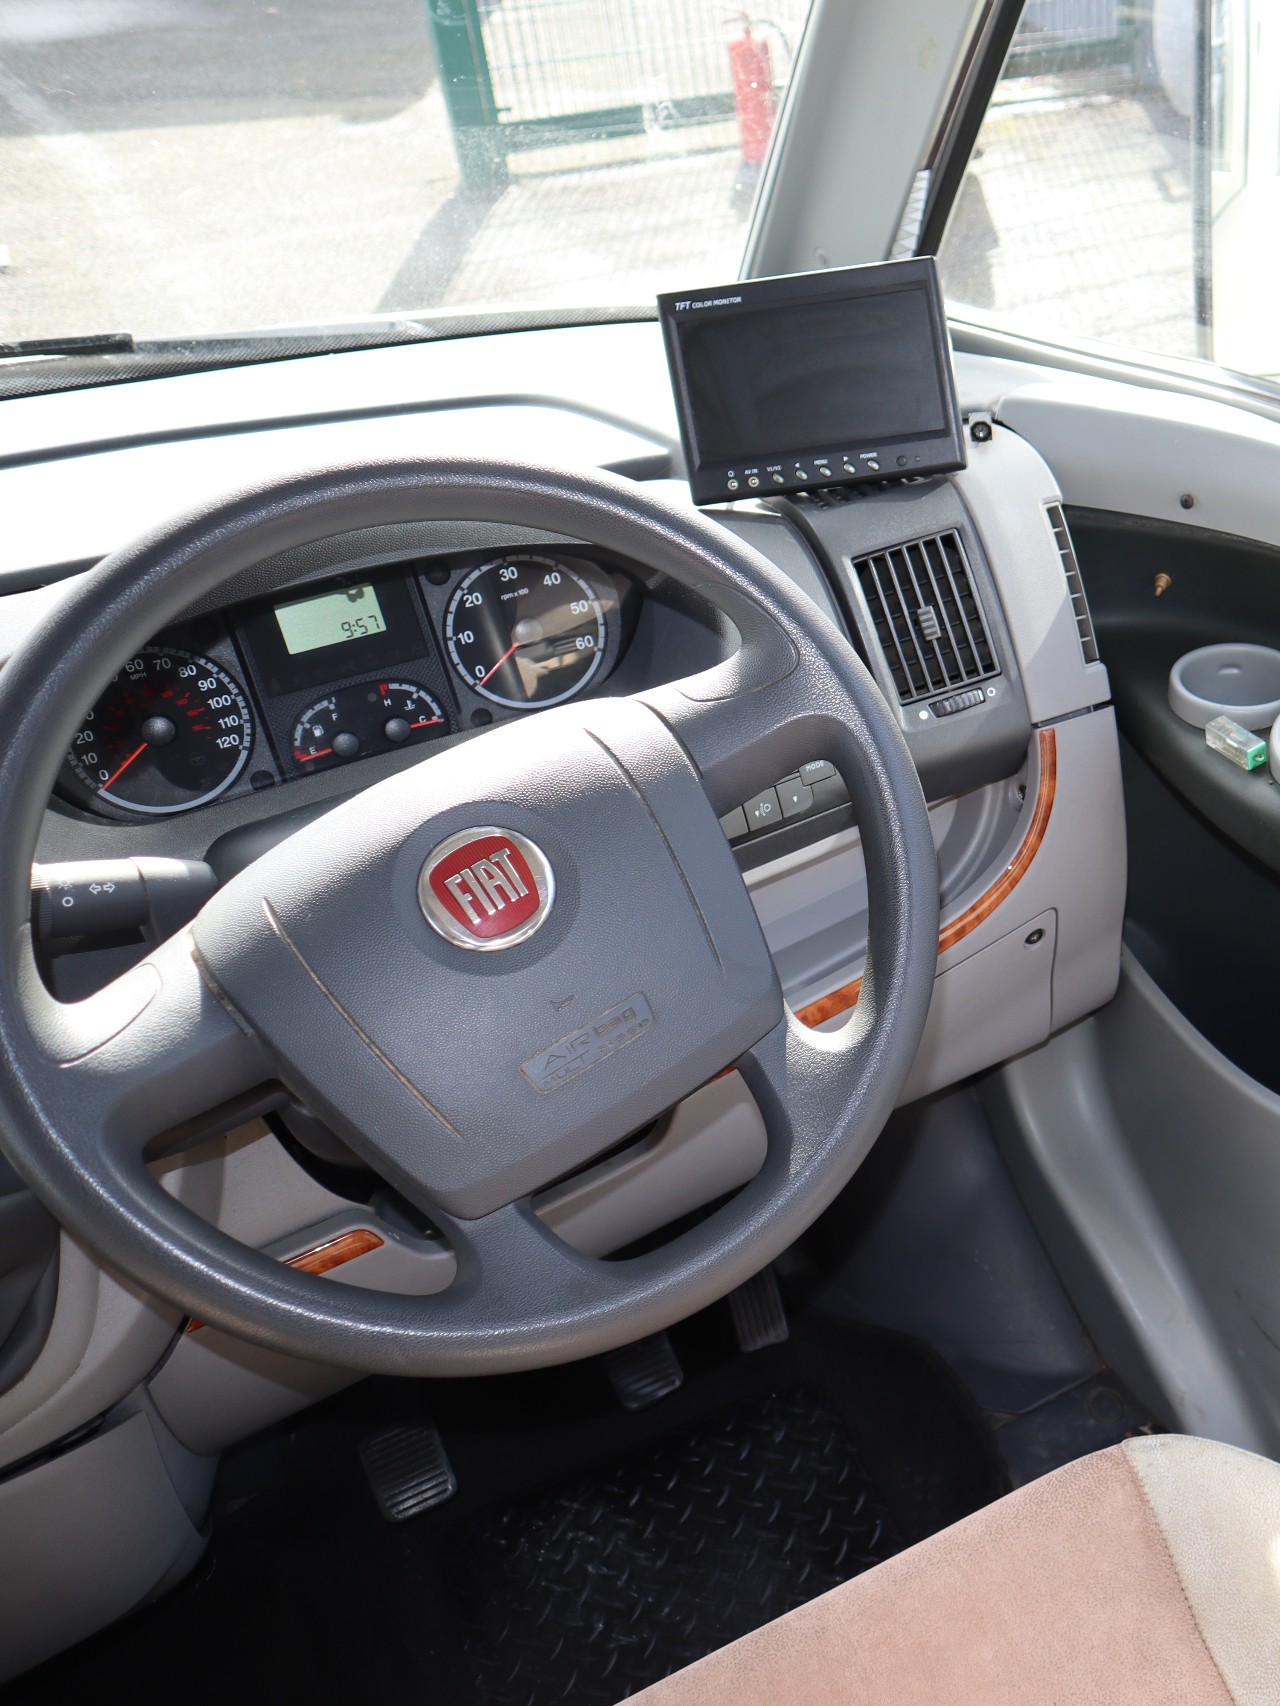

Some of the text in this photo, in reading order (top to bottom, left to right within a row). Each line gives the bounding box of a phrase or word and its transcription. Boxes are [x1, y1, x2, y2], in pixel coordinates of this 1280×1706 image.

[674, 296, 742, 311] TFT COLOR MONITOR
[499, 566, 518, 581] 30
[543, 572, 561, 586] 40
[463, 592, 482, 608] 20
[500, 591, 514, 601] rpm
[570, 600, 589, 615] 50
[341, 615, 380, 638] 9:57
[457, 630, 474, 645] 10
[575, 635, 594, 650] 60
[125, 658, 144, 673] 60
[152, 657, 171, 671] 70
[178, 664, 197, 678] 80
[130, 672, 147, 681] MPH
[475, 665, 485, 678] 0
[198, 677, 217, 691] 90
[207, 694, 231, 710] 100
[383, 698, 392, 707] H
[218, 714, 239, 729] 110
[331, 712, 338, 721] F
[418, 715, 427, 723] C
[75, 730, 94, 745] 20
[215, 734, 239, 749] 120
[309, 746, 317, 755] E
[81, 752, 98, 766] 10
[805, 760, 825, 772] MODE
[98, 769, 109, 781] 0
[444, 848, 529, 925] FIAT
